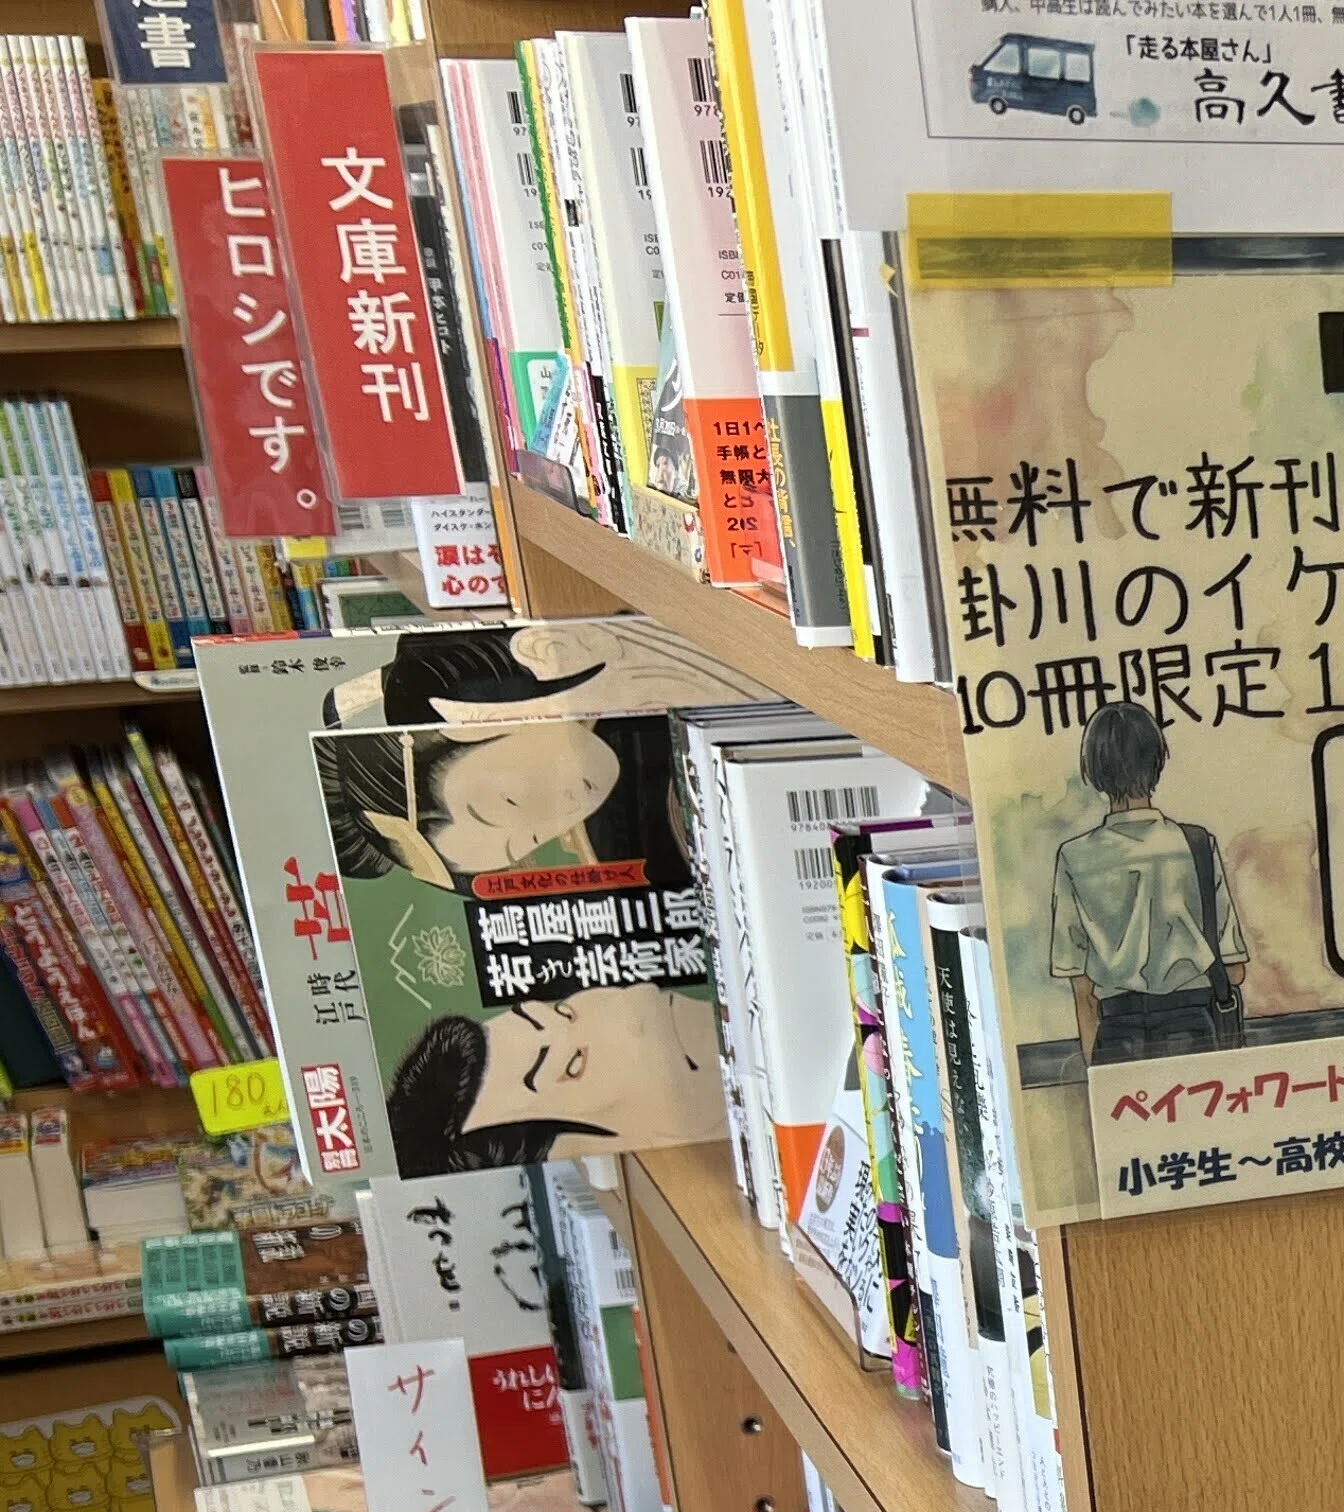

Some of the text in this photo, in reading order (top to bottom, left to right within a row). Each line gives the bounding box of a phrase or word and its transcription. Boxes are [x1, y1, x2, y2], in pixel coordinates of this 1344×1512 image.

[1126, 34, 1273, 65] 「走る本屋さん」
[216, 167, 320, 512] ヒロシです。
[320, 144, 431, 424] 文庫新刊
